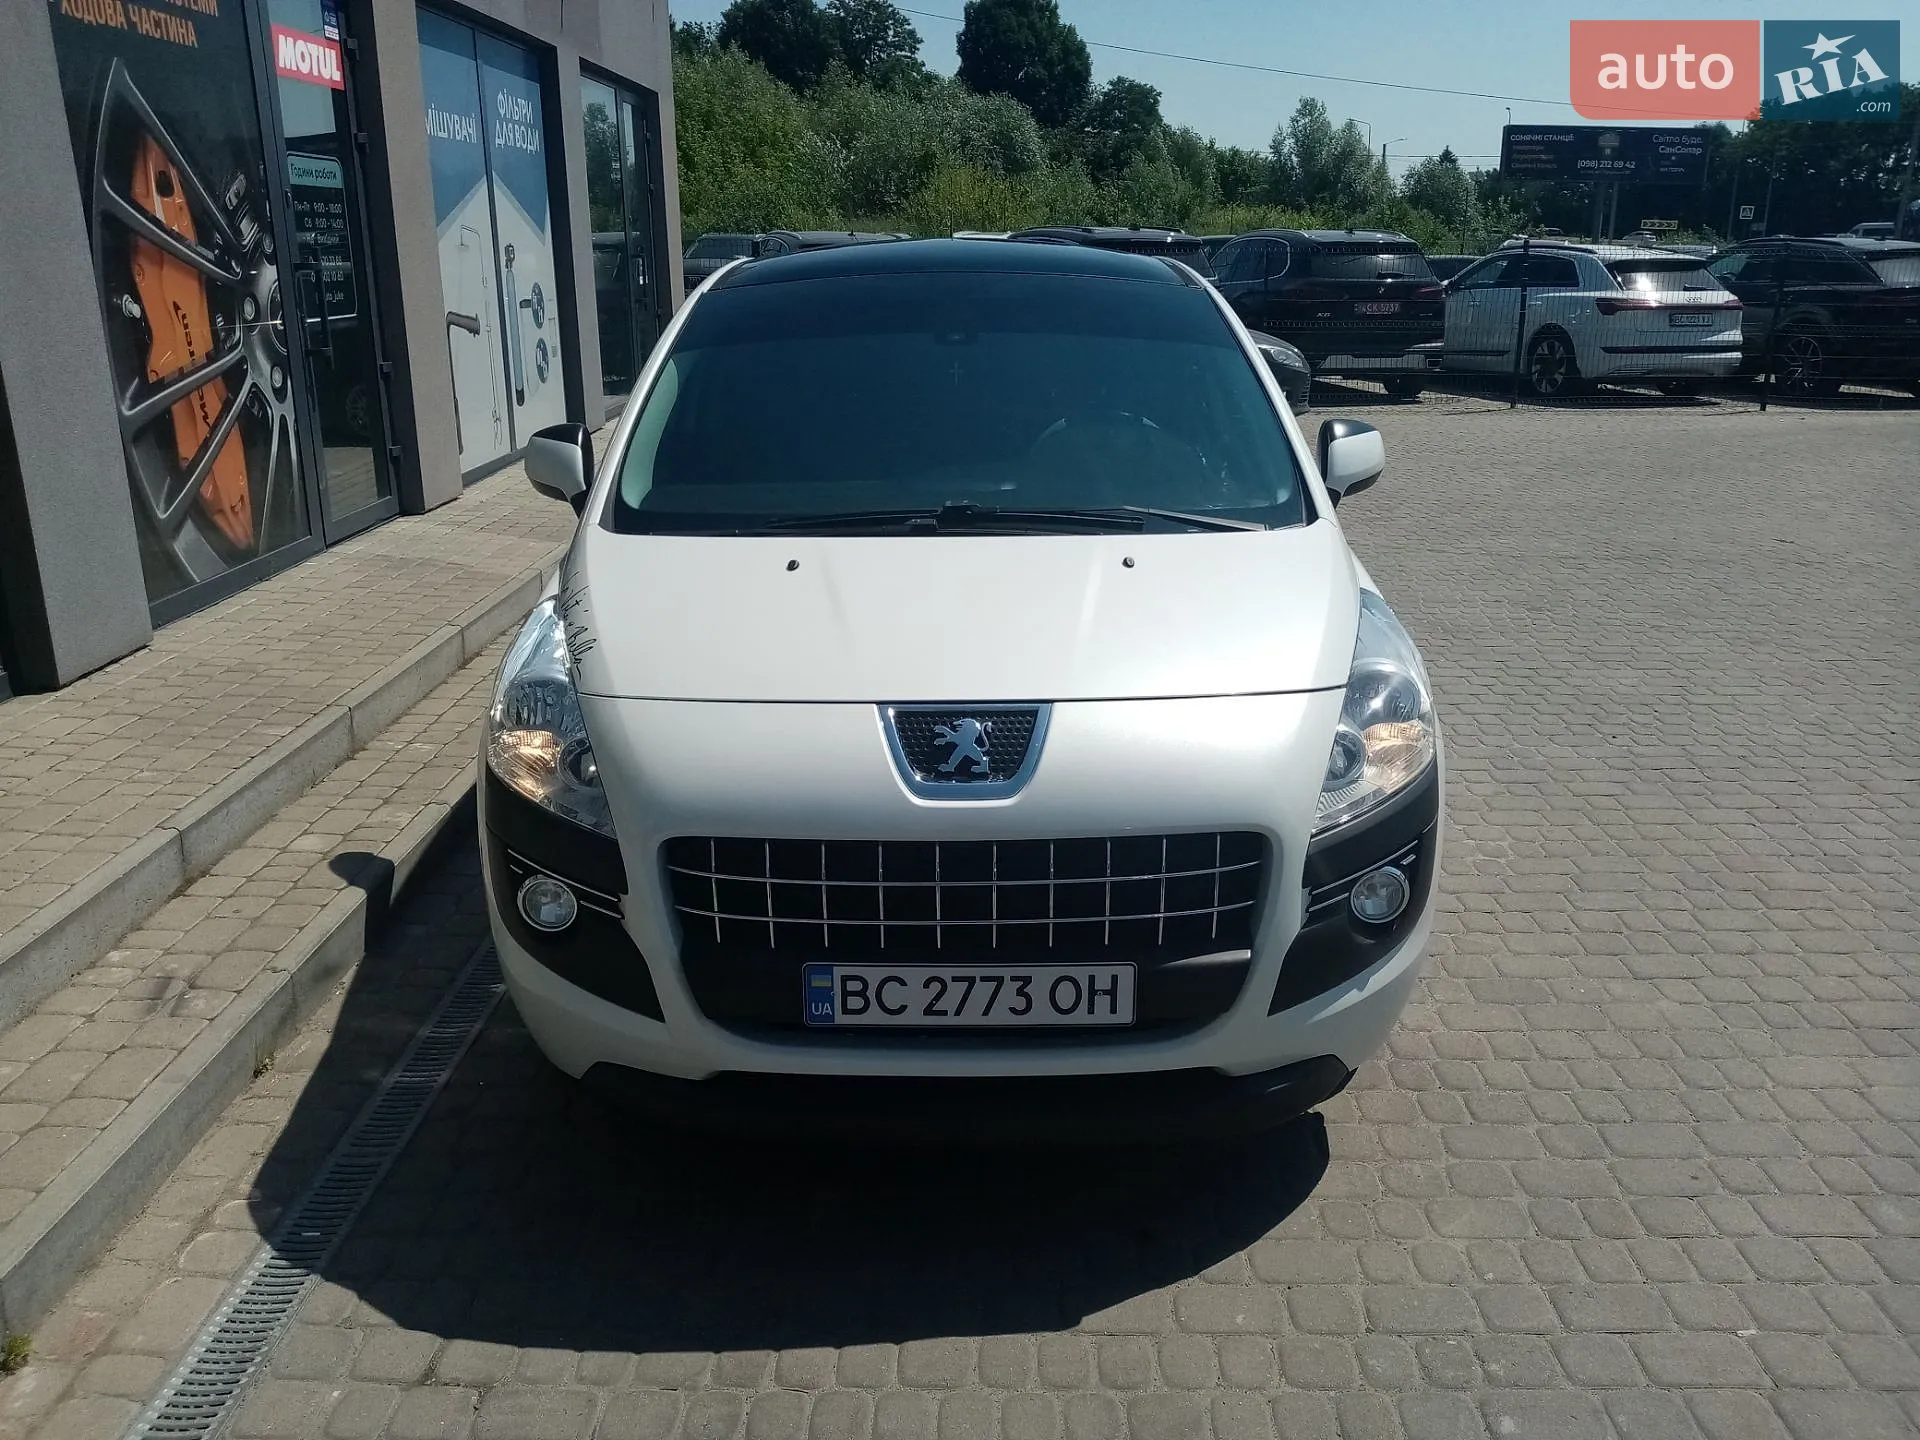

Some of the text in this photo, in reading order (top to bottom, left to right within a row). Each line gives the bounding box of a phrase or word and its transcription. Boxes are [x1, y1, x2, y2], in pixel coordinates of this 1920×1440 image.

[128, 4, 198, 48] ЧАСТИНА
[279, 34, 341, 81] MOTUL
[497, 88, 533, 124] ФІЛЬТРИ
[496, 120, 540, 155] ДЛЯ ВОДИ
[811, 974, 1119, 1017] UA BC 2773 OH
